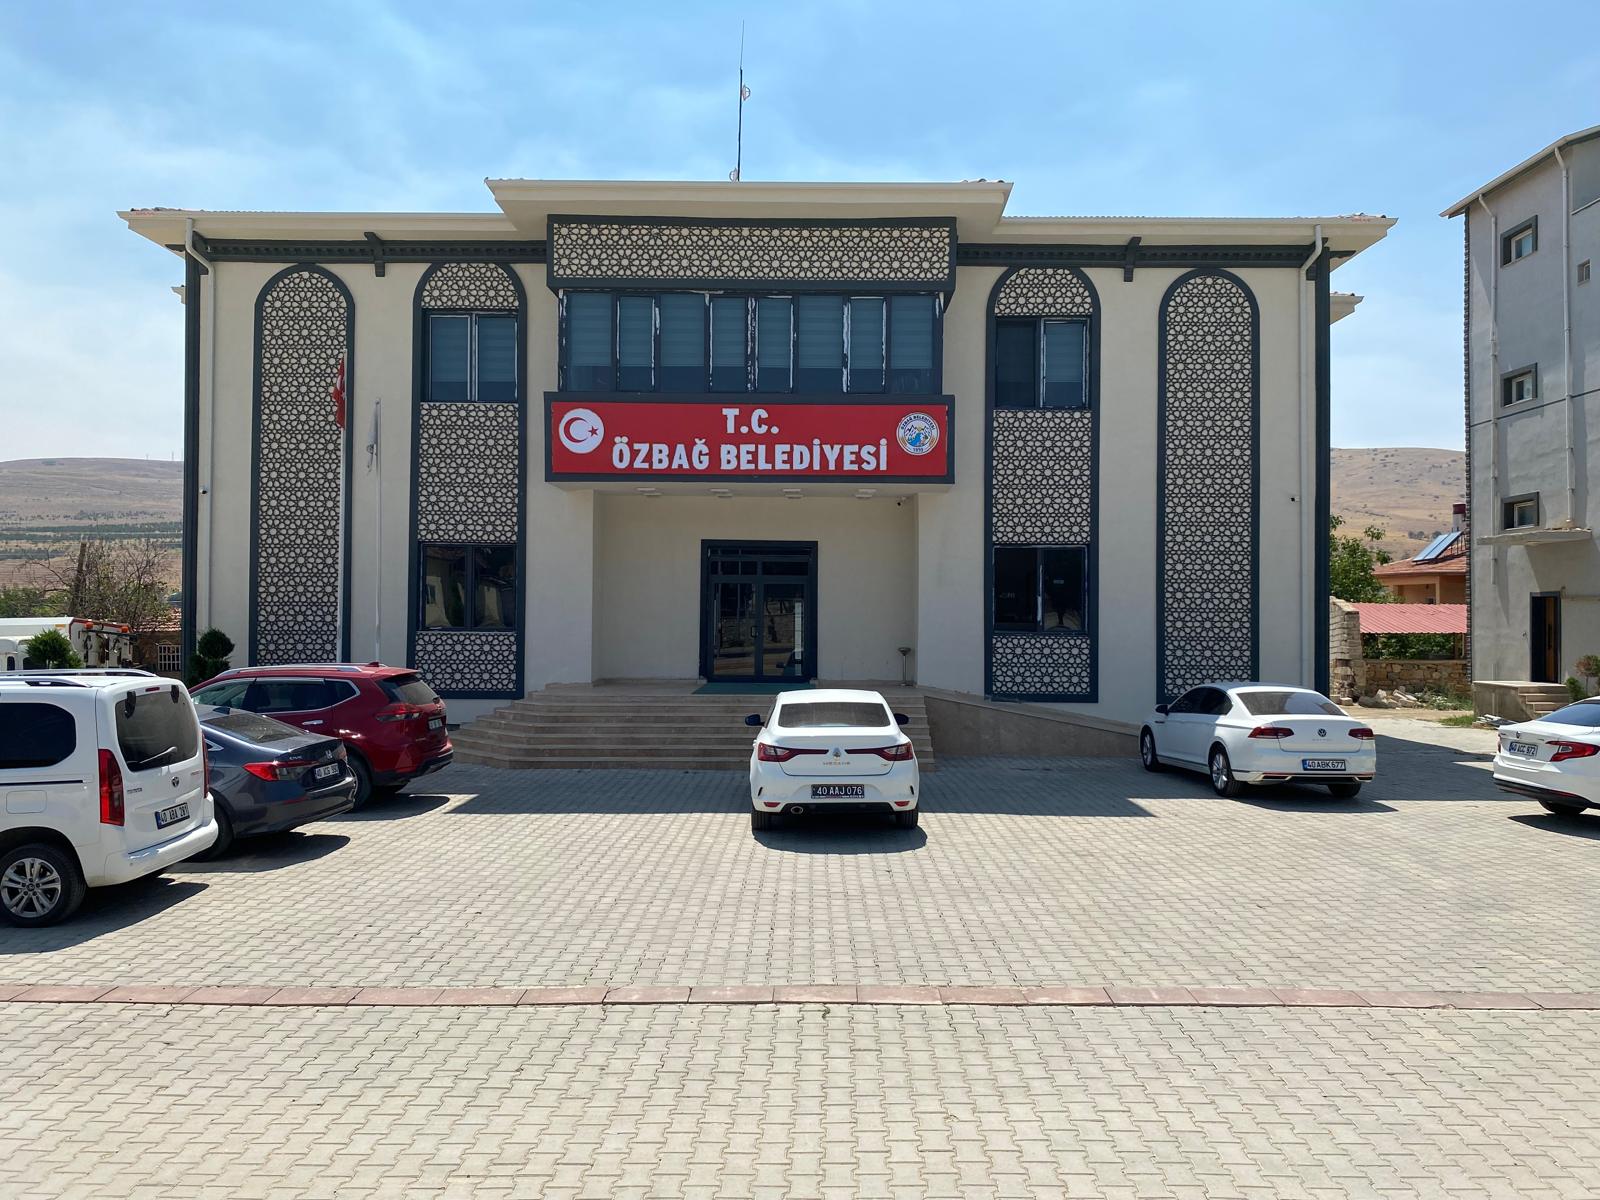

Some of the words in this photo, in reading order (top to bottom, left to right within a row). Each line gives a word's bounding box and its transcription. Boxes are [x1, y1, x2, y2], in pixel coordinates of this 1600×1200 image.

[722, 408, 779, 435] T.C.
[611, 436, 710, 471] ÖZBAĞ
[720, 438, 888, 471] BELEDİYESİ
[817, 786, 828, 795] 40
[829, 786, 845, 795] AAJ
[846, 786, 862, 795] 076
